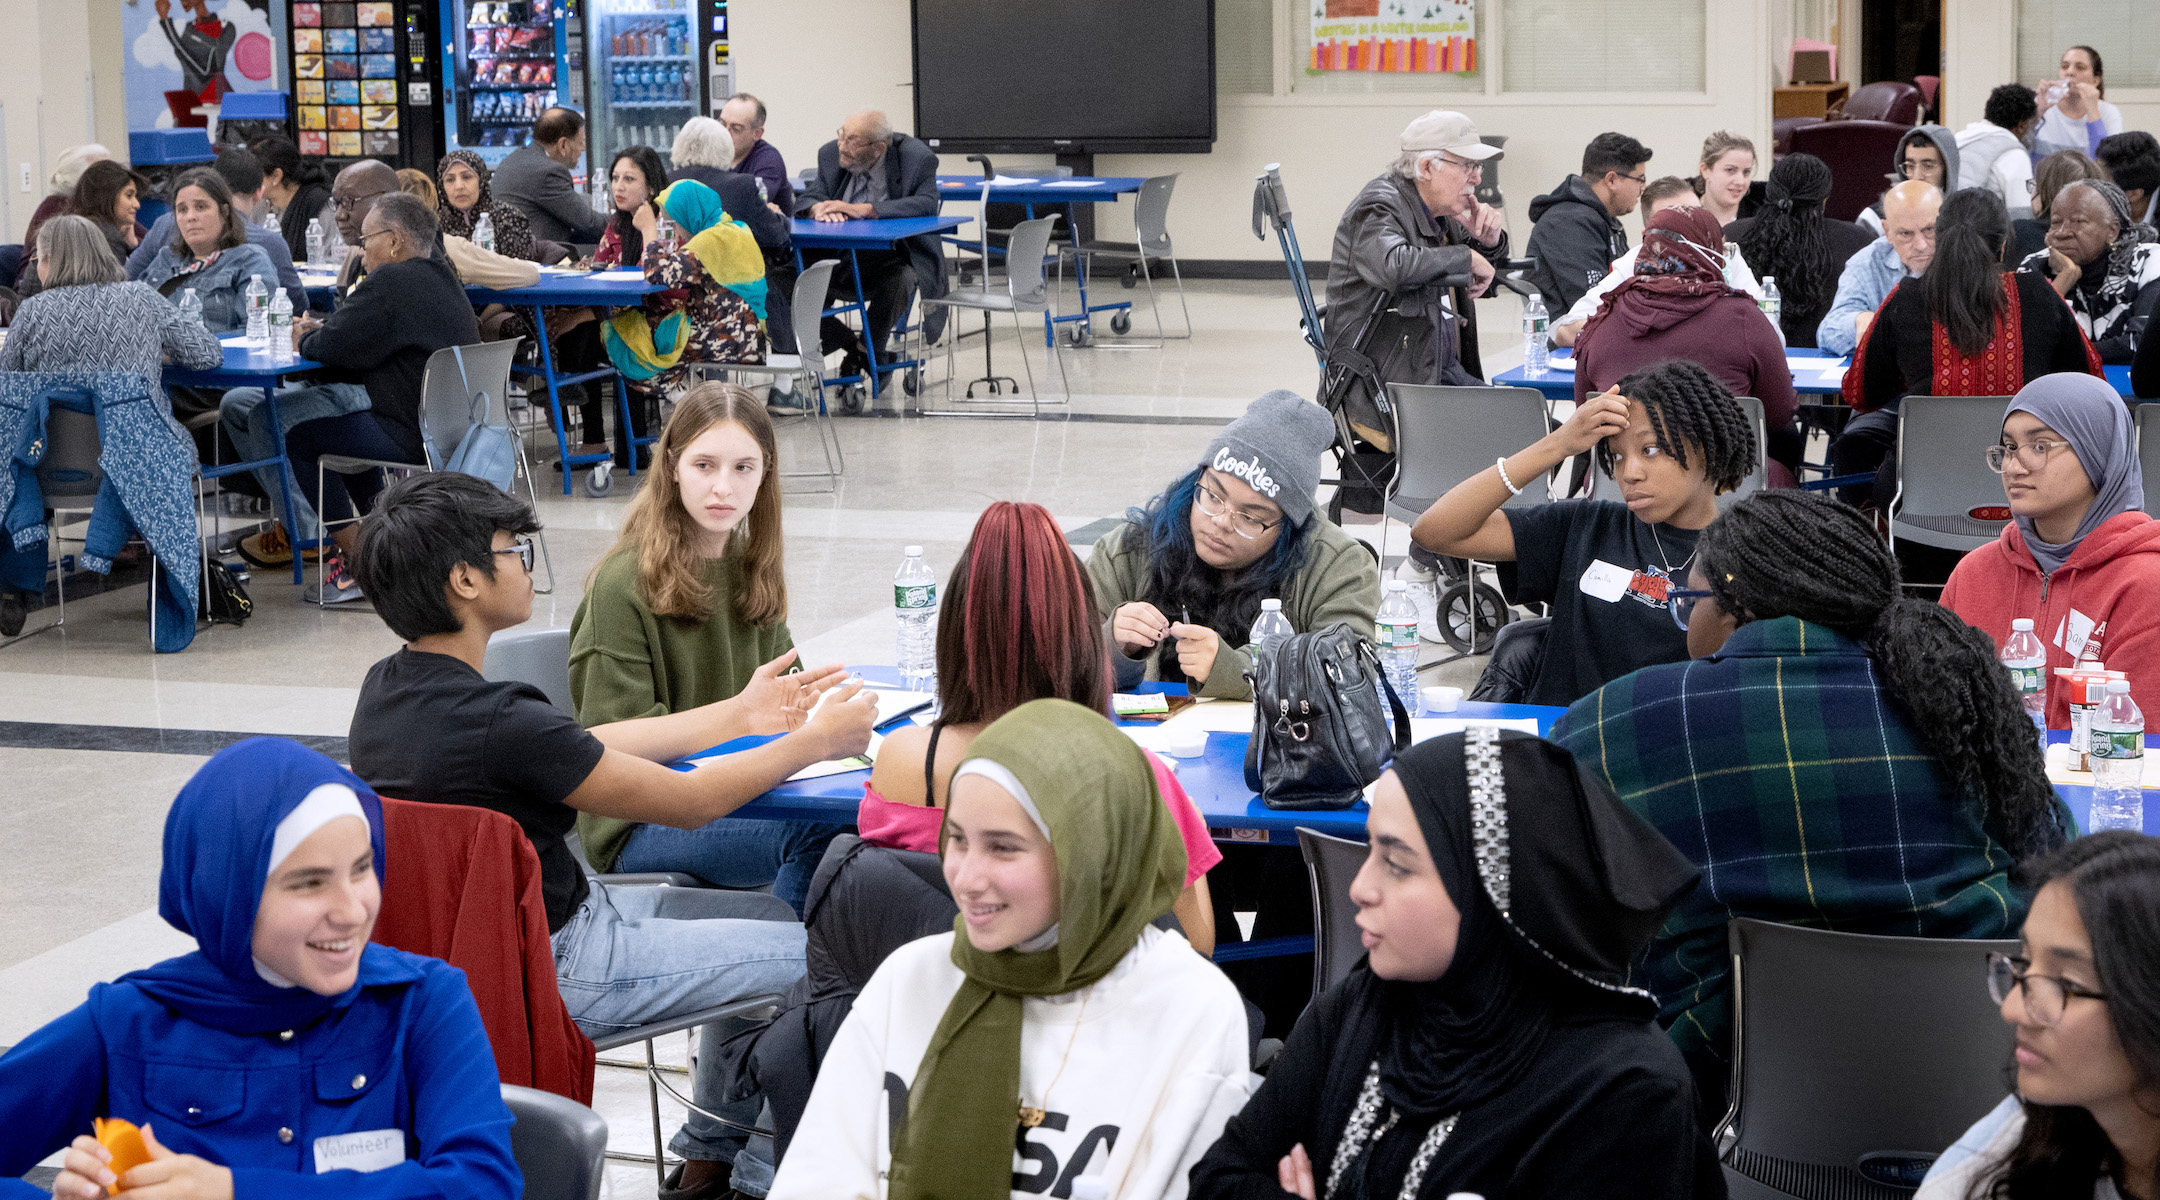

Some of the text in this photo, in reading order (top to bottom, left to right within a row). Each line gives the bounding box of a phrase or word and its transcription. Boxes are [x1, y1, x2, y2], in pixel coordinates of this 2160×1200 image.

[1370, 23, 1379, 34] A
[1213, 446, 1280, 498] Cookies
[316, 1136, 393, 1159] Volunteer
